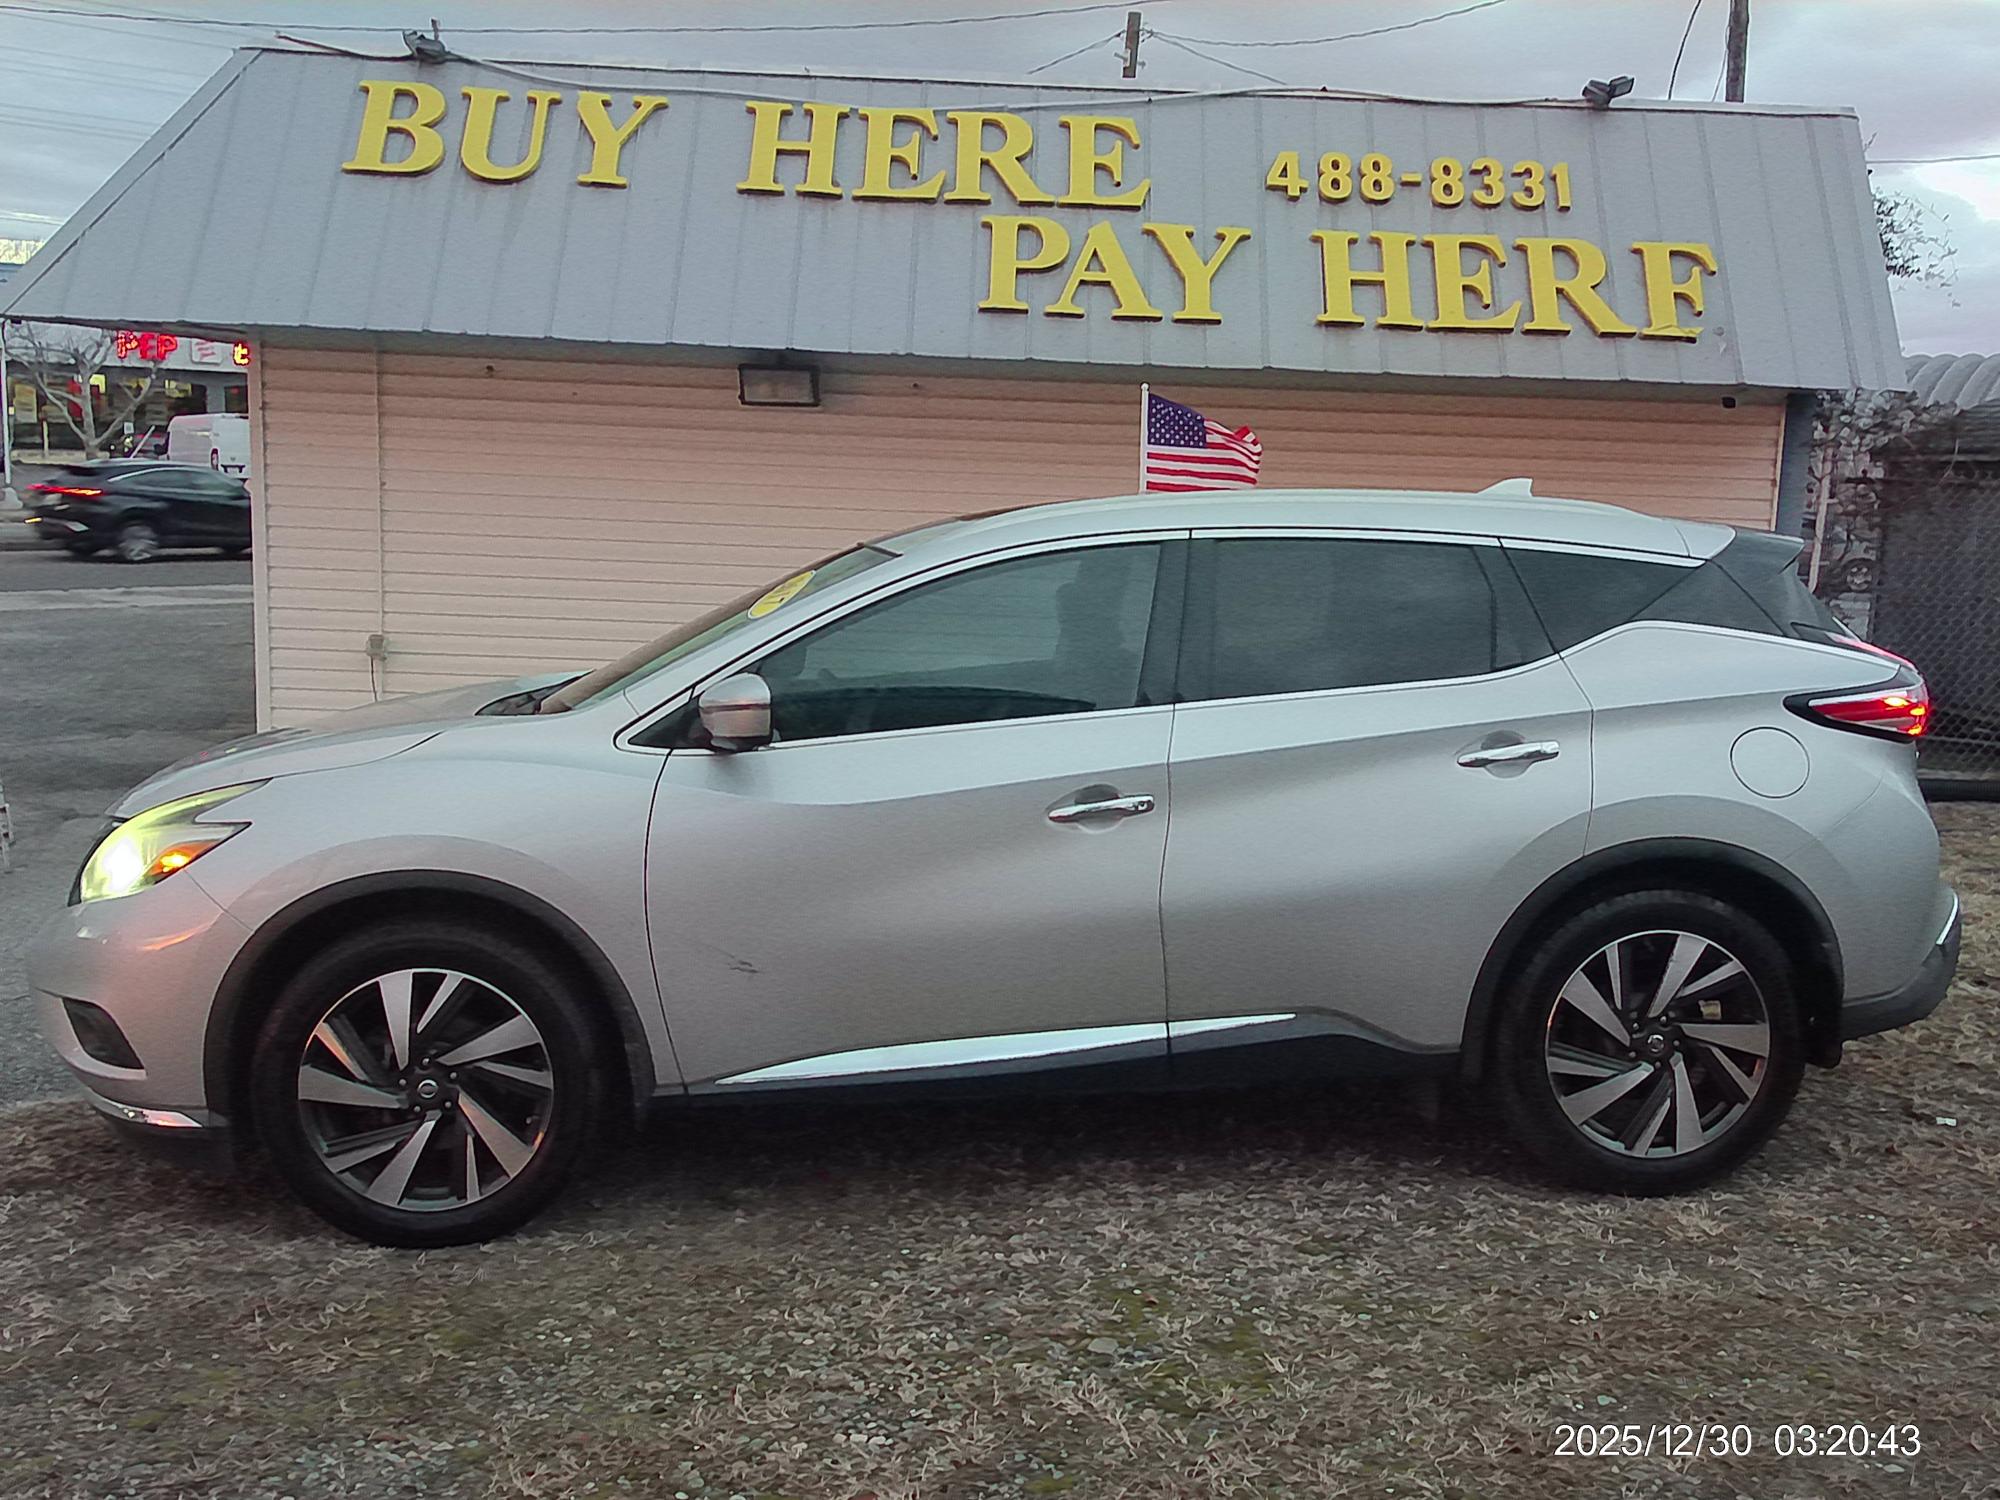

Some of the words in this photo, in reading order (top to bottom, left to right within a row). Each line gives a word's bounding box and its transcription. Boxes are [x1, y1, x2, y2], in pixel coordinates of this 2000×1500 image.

[342, 80, 668, 187] BUY
[736, 101, 1151, 208] HERE
[1265, 151, 1572, 212] 488-8331
[978, 216, 1251, 324] PAY
